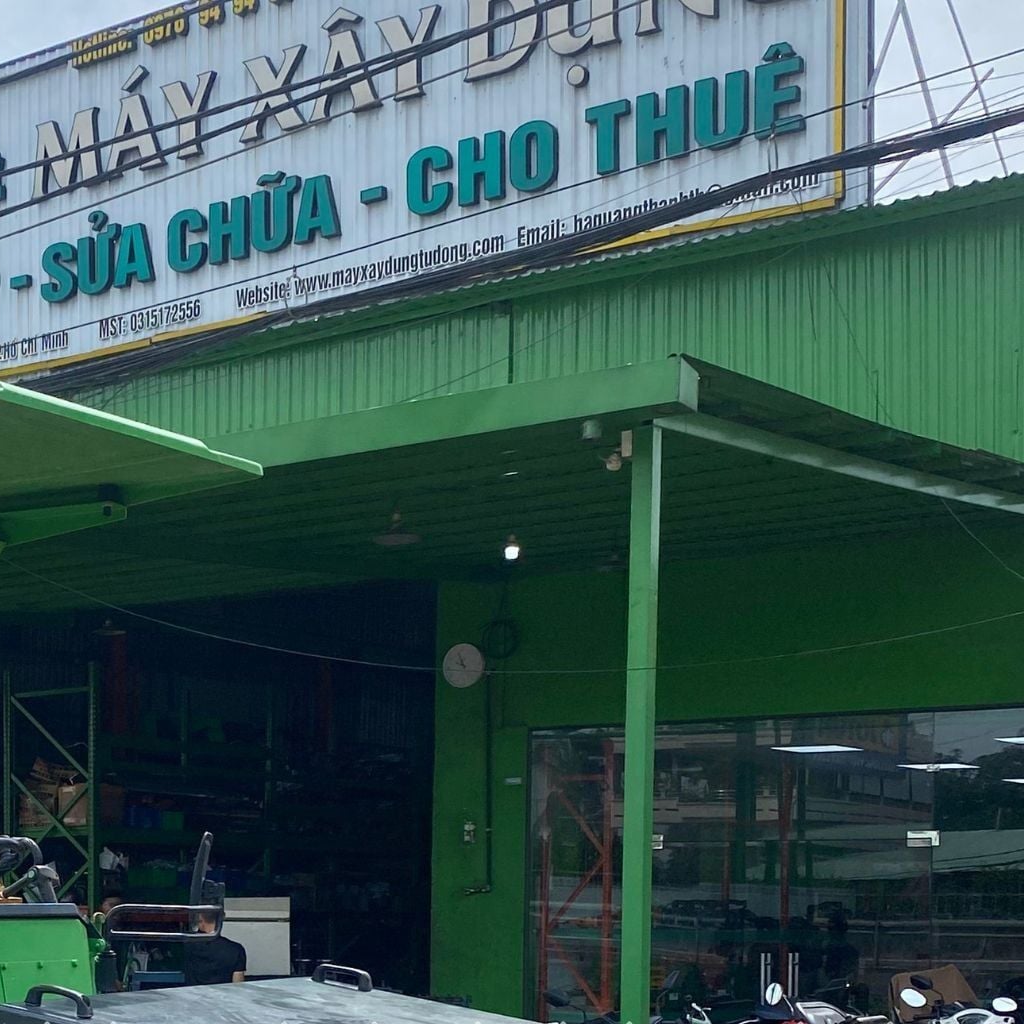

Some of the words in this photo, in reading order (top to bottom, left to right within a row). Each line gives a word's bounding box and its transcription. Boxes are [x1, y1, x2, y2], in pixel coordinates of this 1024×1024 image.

[10, 274, 32, 289] -
[41, 210, 156, 303] SỬA
[167, 171, 342, 273] CHỮA
[360, 185, 388, 205] -
[406, 119, 559, 216] CHO
[585, 42, 806, 175] THUÊ
[31, 65, 218, 200] MÁY
[240, 4, 441, 145] XÂY
[99, 318, 126, 340] MST:
[236, 280, 291, 308] Website:
[295, 234, 505, 297] www.mayxaydungtudong.com
[517, 217, 564, 248] Email:
